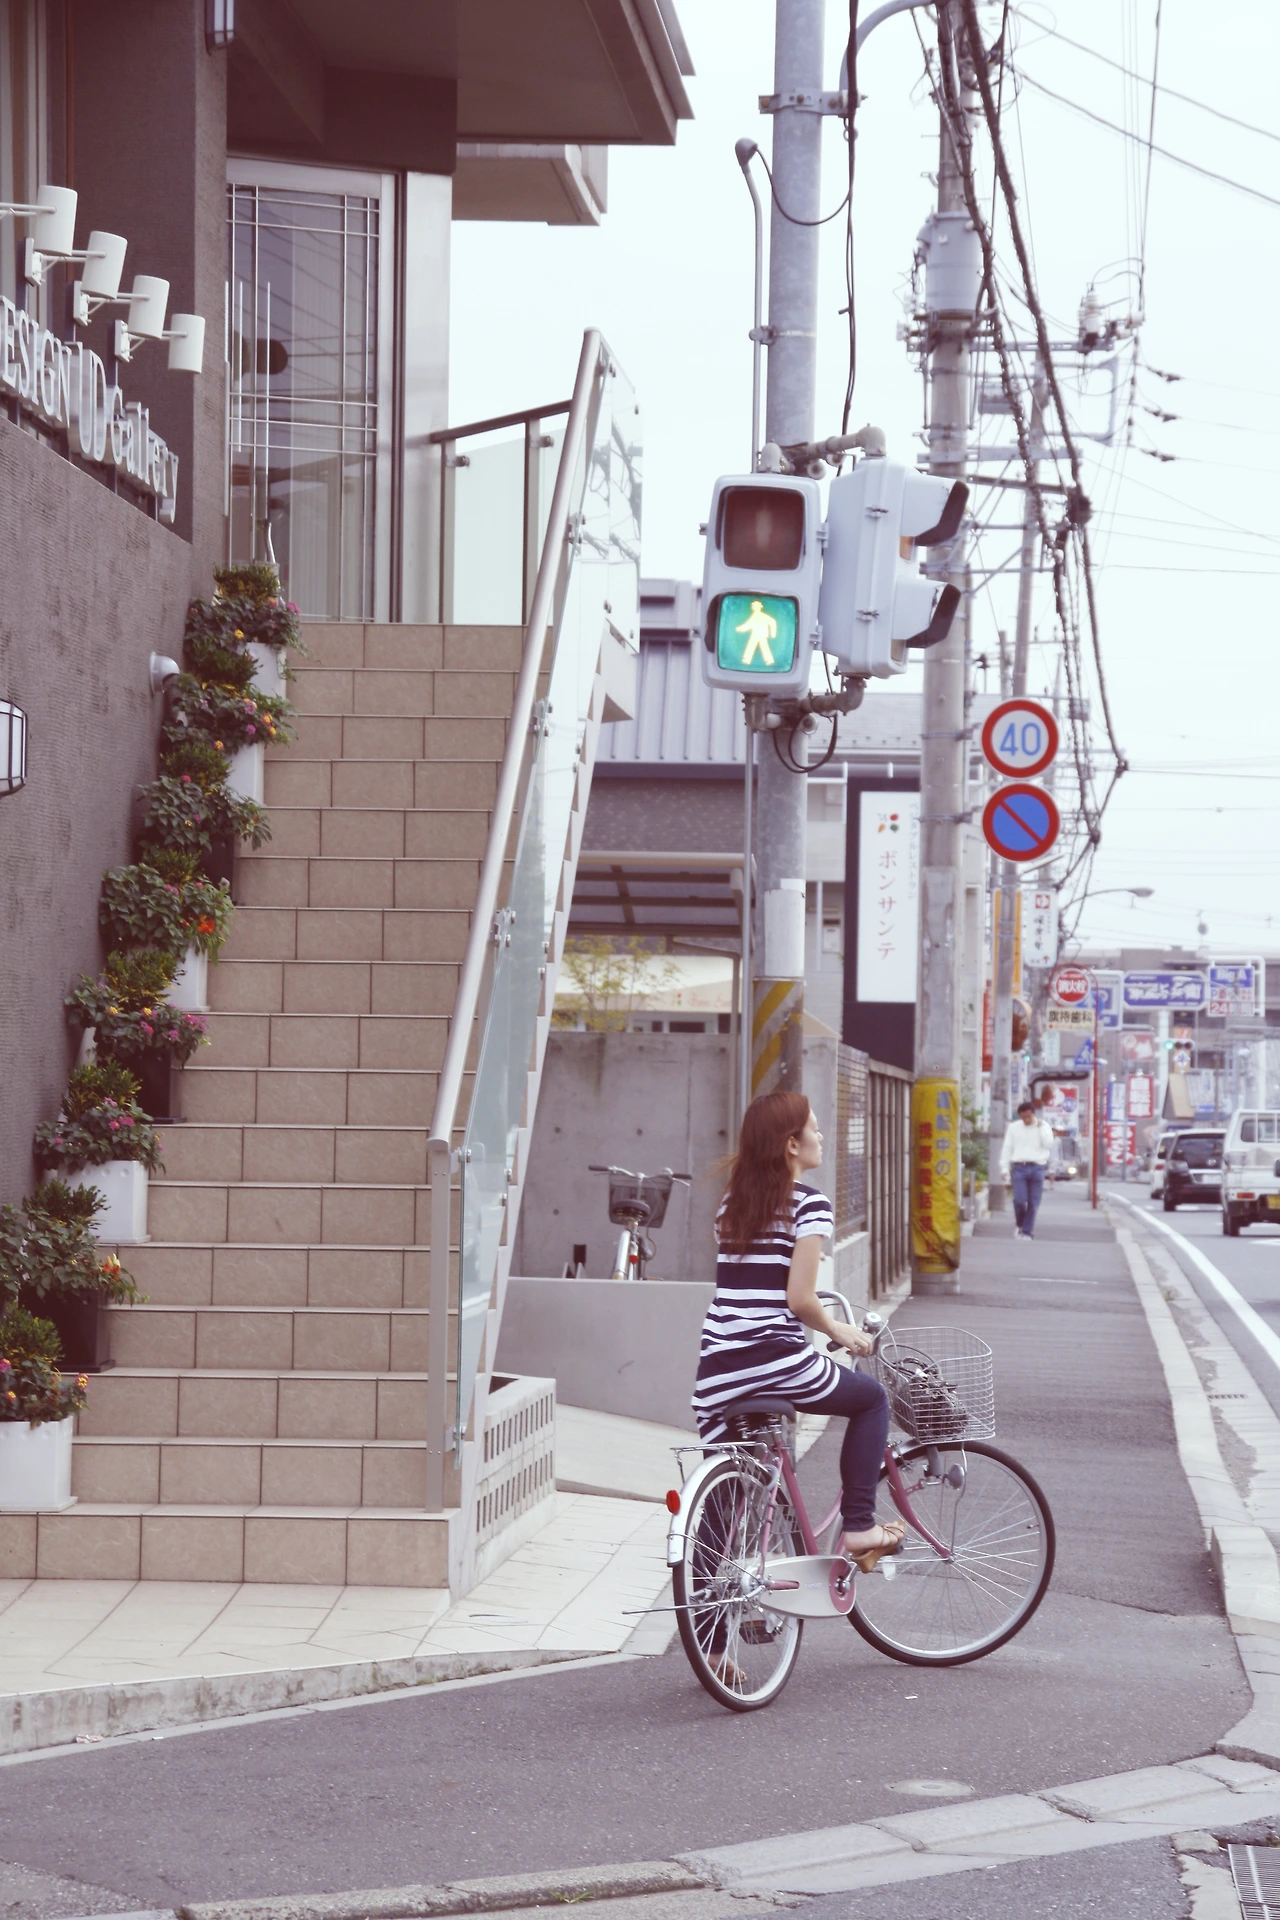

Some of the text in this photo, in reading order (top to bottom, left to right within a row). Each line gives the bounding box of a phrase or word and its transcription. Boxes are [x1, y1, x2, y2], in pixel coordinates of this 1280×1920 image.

[65, 341, 107, 463] UD
[110, 385, 179, 524] Gallery
[1000, 721, 1041, 756] 40
[877, 850, 898, 961] ボンサンテ
[1058, 979, 1088, 994] 消火栓
